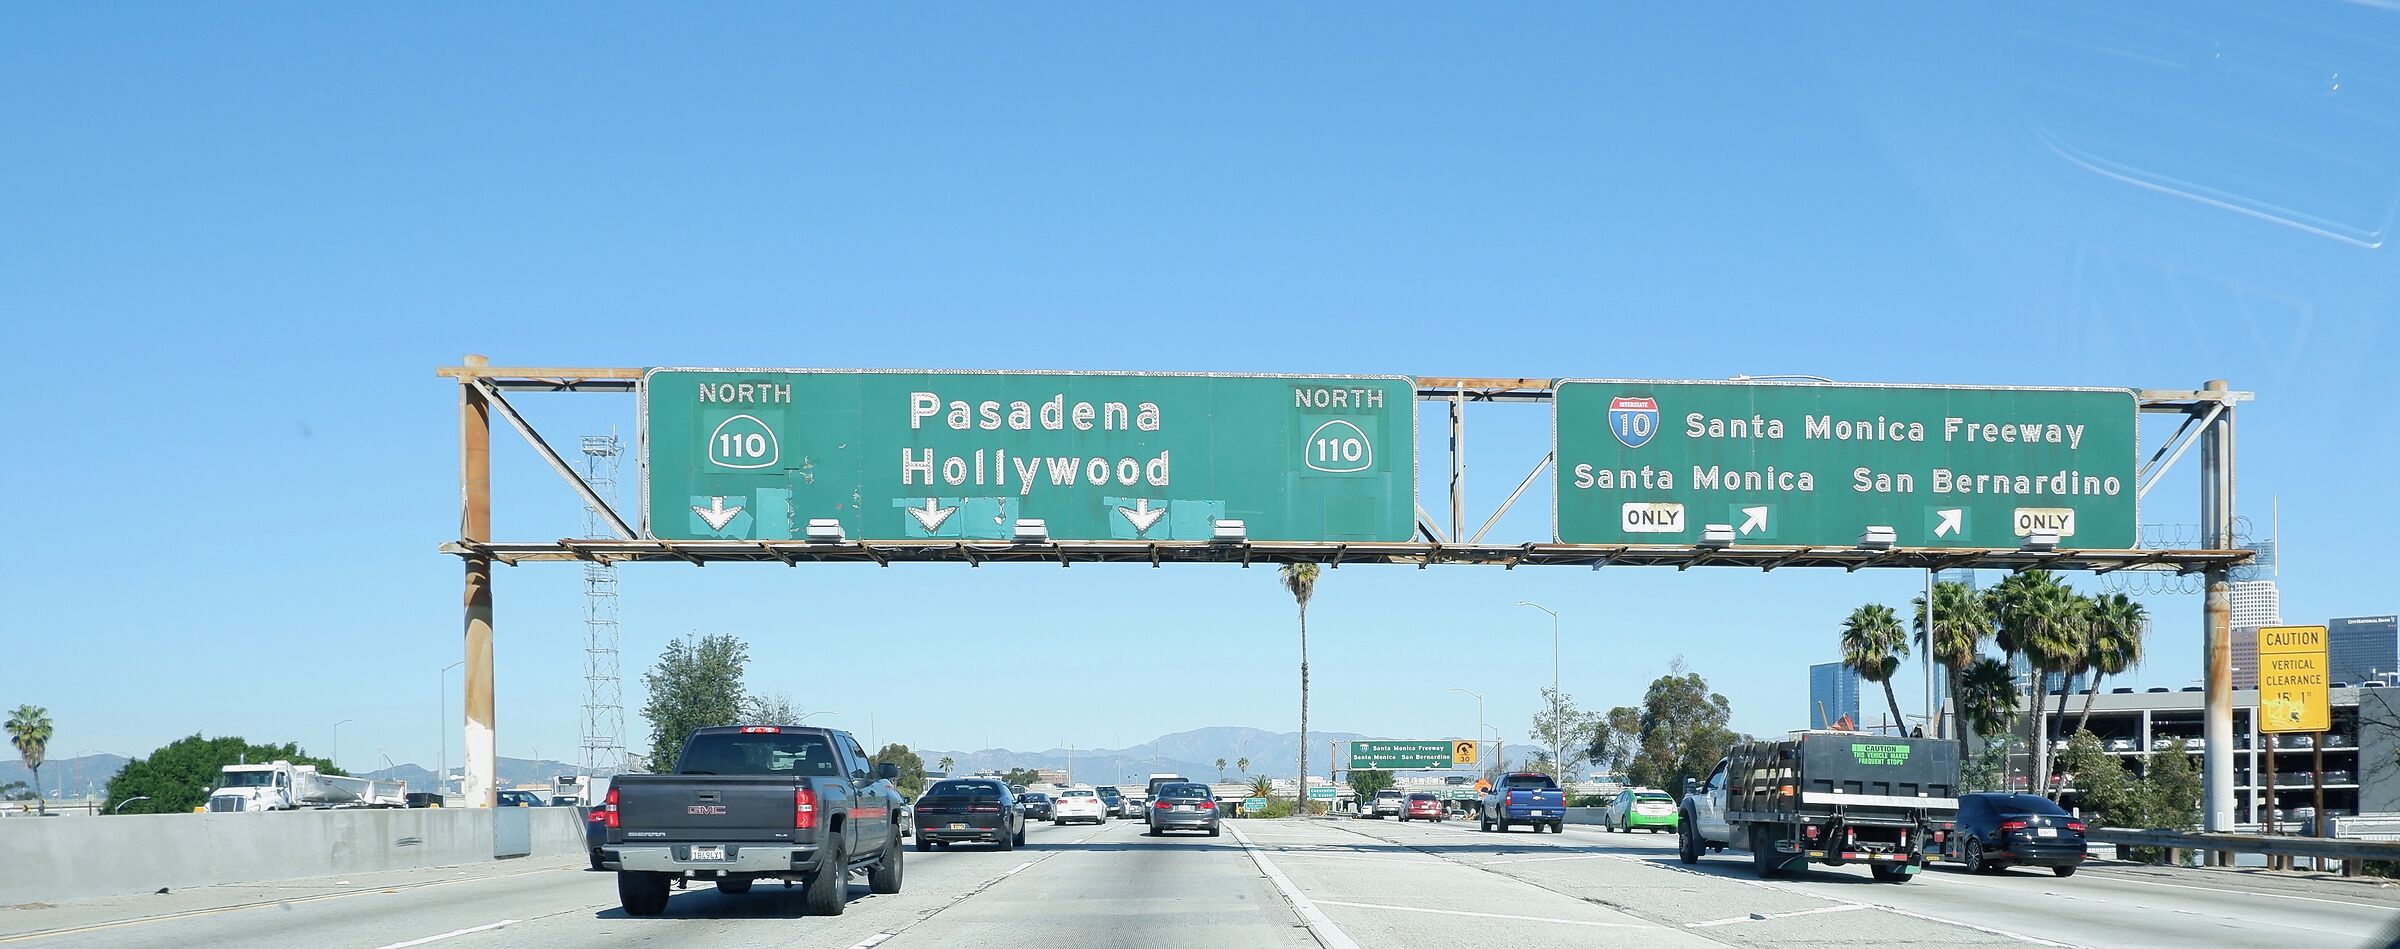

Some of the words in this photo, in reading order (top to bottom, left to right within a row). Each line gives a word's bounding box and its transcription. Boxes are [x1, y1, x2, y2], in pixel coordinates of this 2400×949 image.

[699, 383, 791, 403] NORTH
[1295, 388, 1383, 408] NORTH
[911, 391, 1160, 431] Pasadena
[1620, 413, 1651, 437] 10
[1685, 412, 1784, 439] Santa
[1805, 414, 1924, 443] Monica
[1944, 417, 2085, 450] Freeway
[719, 433, 766, 458] 110
[1317, 438, 1362, 462] 110
[902, 447, 1169, 496] Hollywood
[1574, 463, 1674, 490] Santa
[1693, 464, 1814, 491] Monica
[1852, 467, 1914, 493] San
[1932, 468, 2121, 496] Bernardino
[1627, 510, 1679, 526] ONLY
[2019, 514, 2070, 530] ONLY
[2266, 631, 2319, 646] CAUTION
[2271, 659, 2315, 670] VERTICAL
[2266, 674, 2322, 686] CLEARANCE
[1886, 758, 1904, 766] STOPS
[687, 805, 727, 815] GMC
